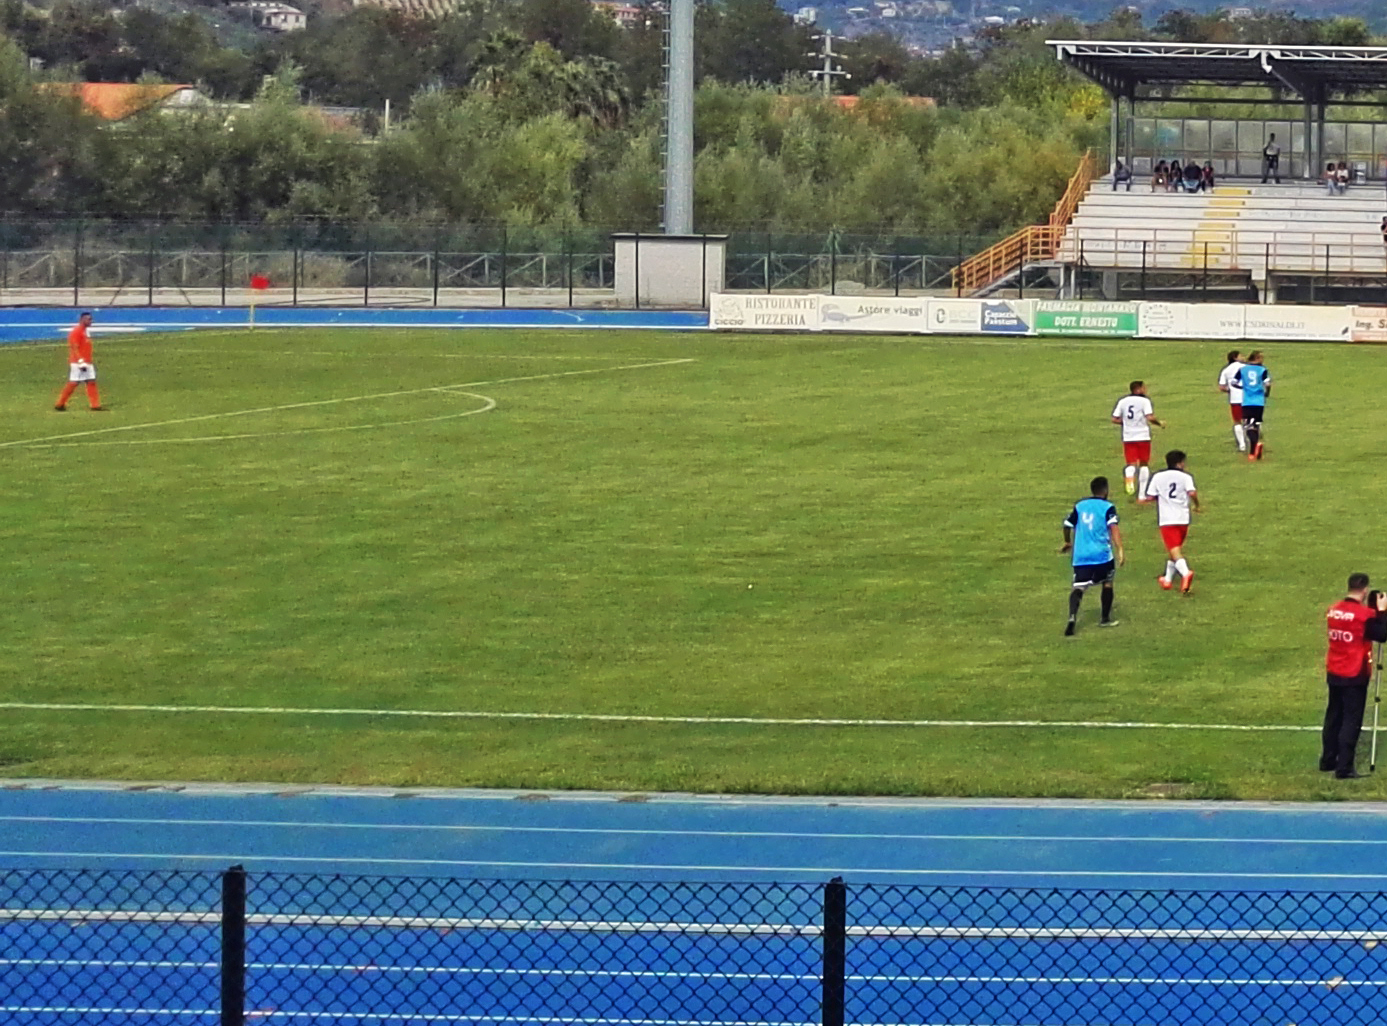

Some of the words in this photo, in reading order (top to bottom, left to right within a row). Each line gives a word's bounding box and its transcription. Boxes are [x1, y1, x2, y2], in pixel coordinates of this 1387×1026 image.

[745, 298, 816, 310] RISTORANTE
[857, 305, 890, 315] Astore
[894, 306, 923, 317] viaggi
[754, 313, 806, 325] PIZZERIA
[1355, 320, 1374, 330] Ing.
[1248, 371, 1257, 386] 9
[1127, 405, 1135, 420] 5
[1168, 482, 1177, 499] 2
[1082, 512, 1094, 530] 4
